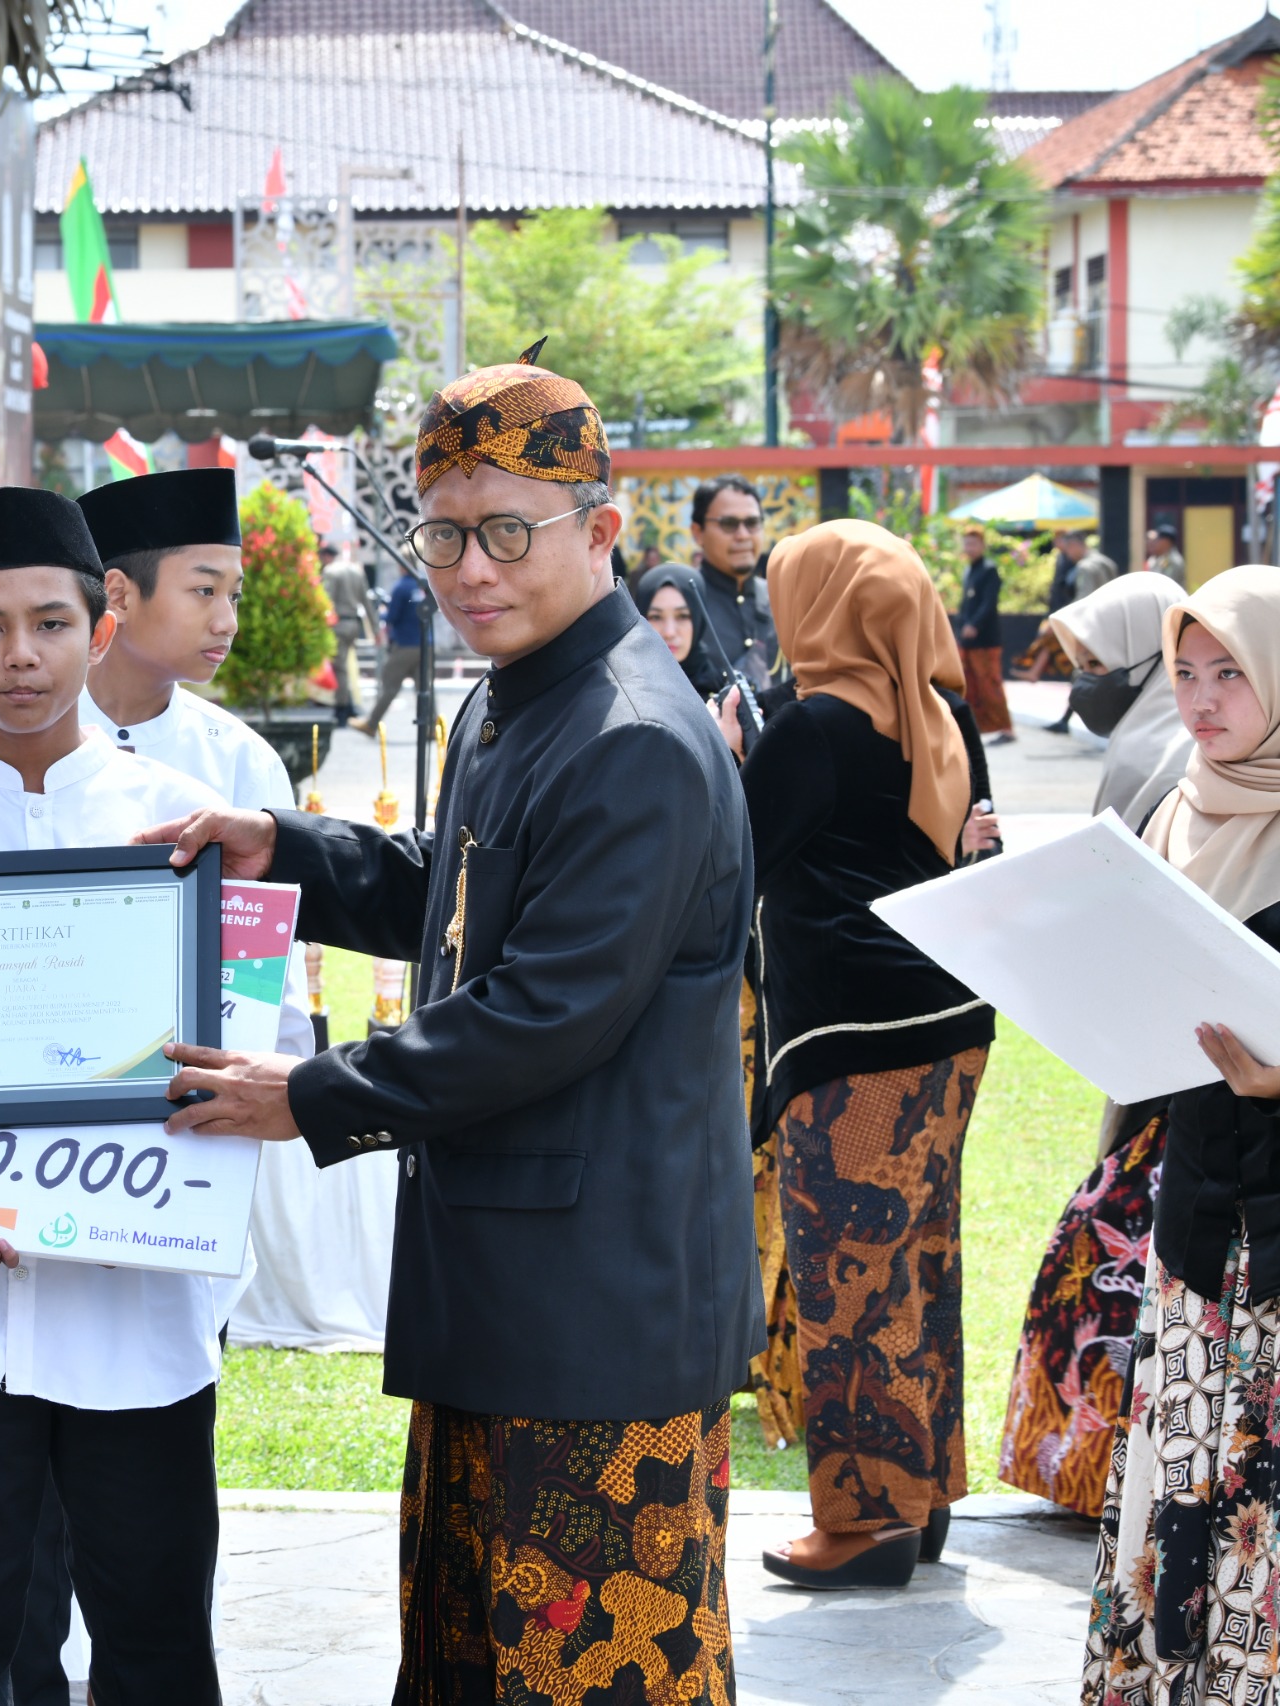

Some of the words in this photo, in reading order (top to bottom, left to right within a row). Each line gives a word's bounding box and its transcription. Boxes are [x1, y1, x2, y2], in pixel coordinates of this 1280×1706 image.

[207, 728, 219, 737] 53
[43, 954, 86, 970] Rasidi
[4, 984, 37, 994] JUARA
[41, 983, 47, 992] 2
[73, 1001, 105, 1009] SUMENEP
[89, 1226, 129, 1244] Bank
[131, 1230, 218, 1252] Muamalat
